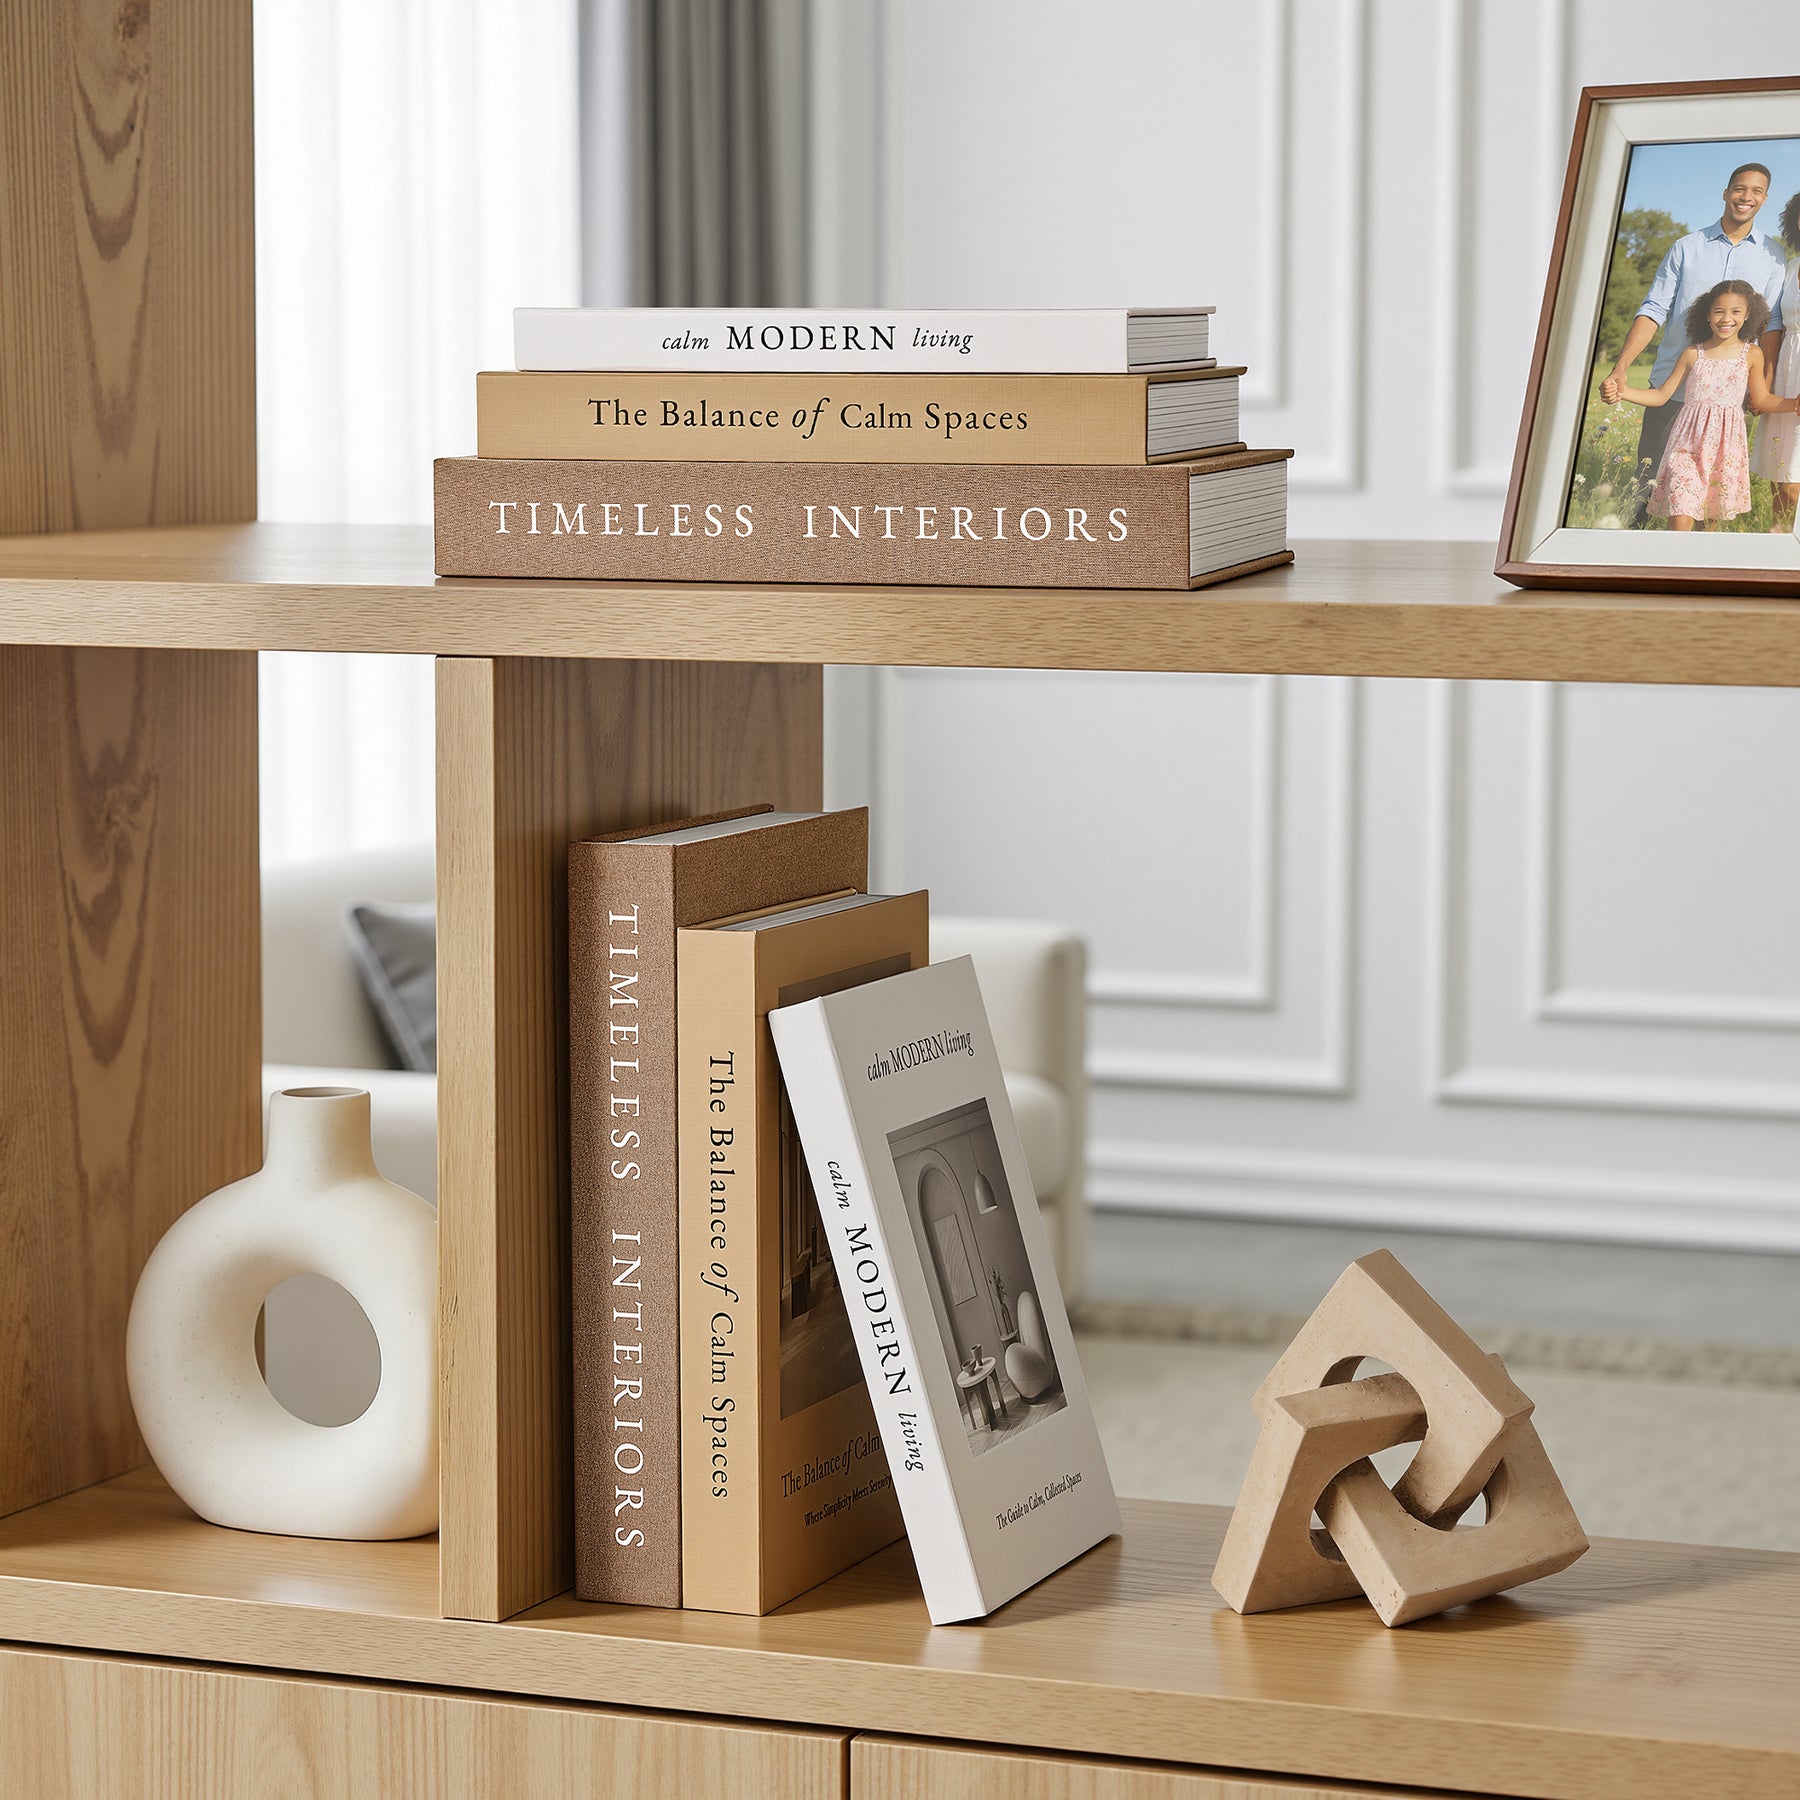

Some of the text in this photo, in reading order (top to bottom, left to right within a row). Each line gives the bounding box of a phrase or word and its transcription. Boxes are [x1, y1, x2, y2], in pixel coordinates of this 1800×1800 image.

[662, 325, 974, 354] calm MODERN living
[588, 397, 1028, 439] The Balance of Calm Spaces
[489, 501, 1129, 542] TIMELESS INTERIORS
[867, 1030, 974, 1081] calm MODERN living
[608, 904, 644, 1549] TIMELESS INTERIORS
[700, 1051, 739, 1498] The Balance of Calm Spaces
[827, 1160, 924, 1472] calm MODERN living
[782, 1431, 880, 1498] The Balance of Calm
[804, 1511, 823, 1527] Where
[823, 1494, 852, 1518] Simplicity
[852, 1486, 869, 1503] Meets
[996, 1513, 1007, 1530] The
[1007, 1503, 1024, 1523] Guide
[1024, 1503, 1030, 1514] to
[1028, 1492, 1045, 1511] Calm,
[1045, 1476, 1067, 1501] Collected
